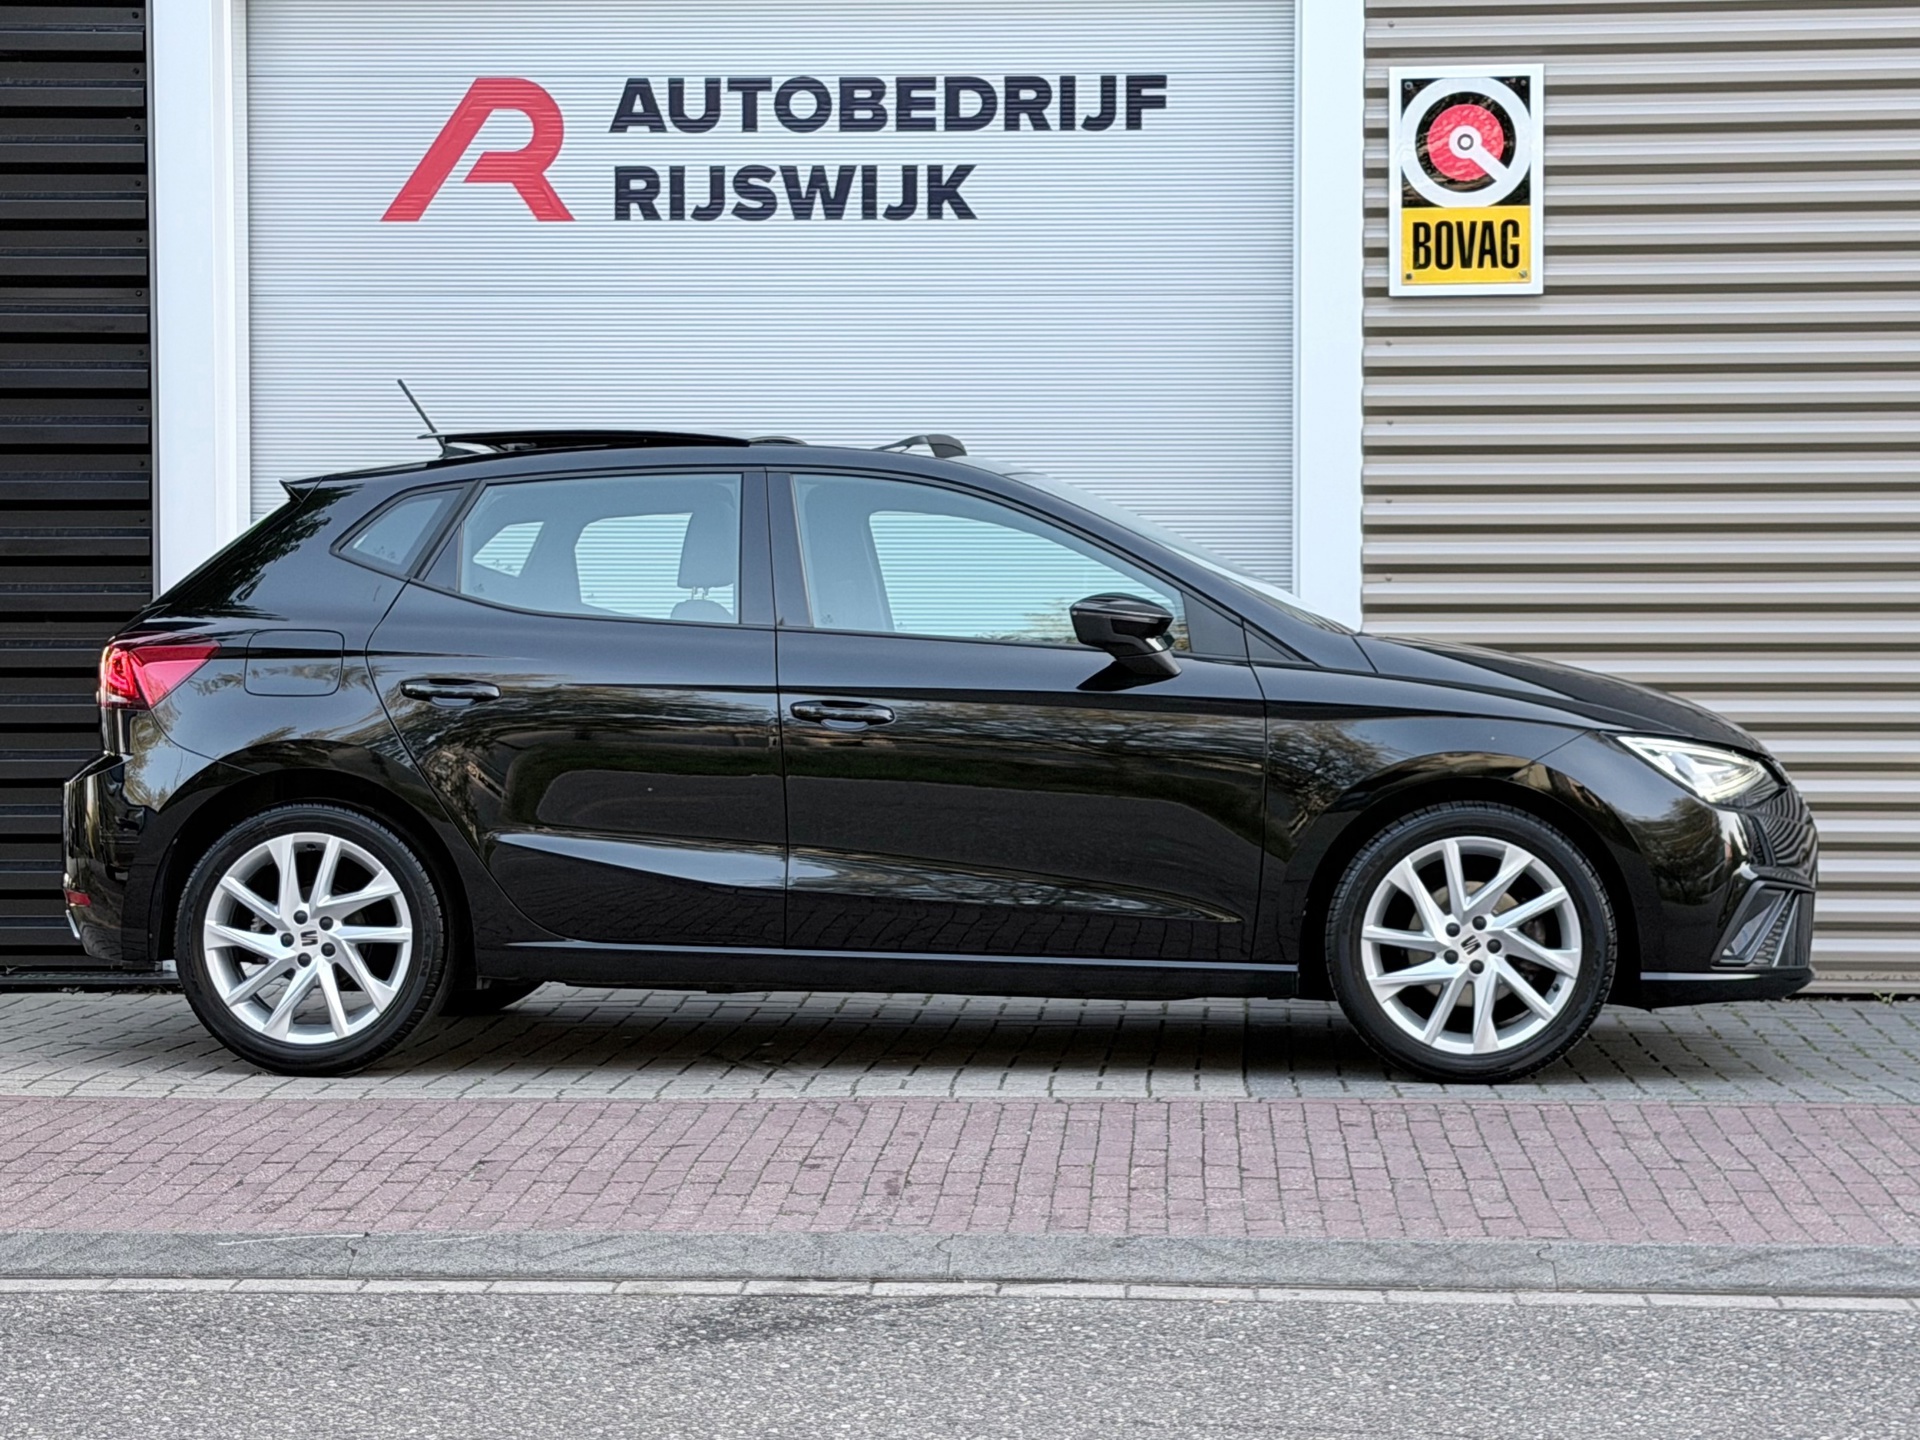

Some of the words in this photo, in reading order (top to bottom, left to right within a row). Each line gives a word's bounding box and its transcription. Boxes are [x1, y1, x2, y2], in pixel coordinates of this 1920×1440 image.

[609, 74, 1167, 134] AUTOBEDRIJF
[614, 164, 977, 221] RIJSWIJK
[1412, 219, 1520, 270] BOVAG
